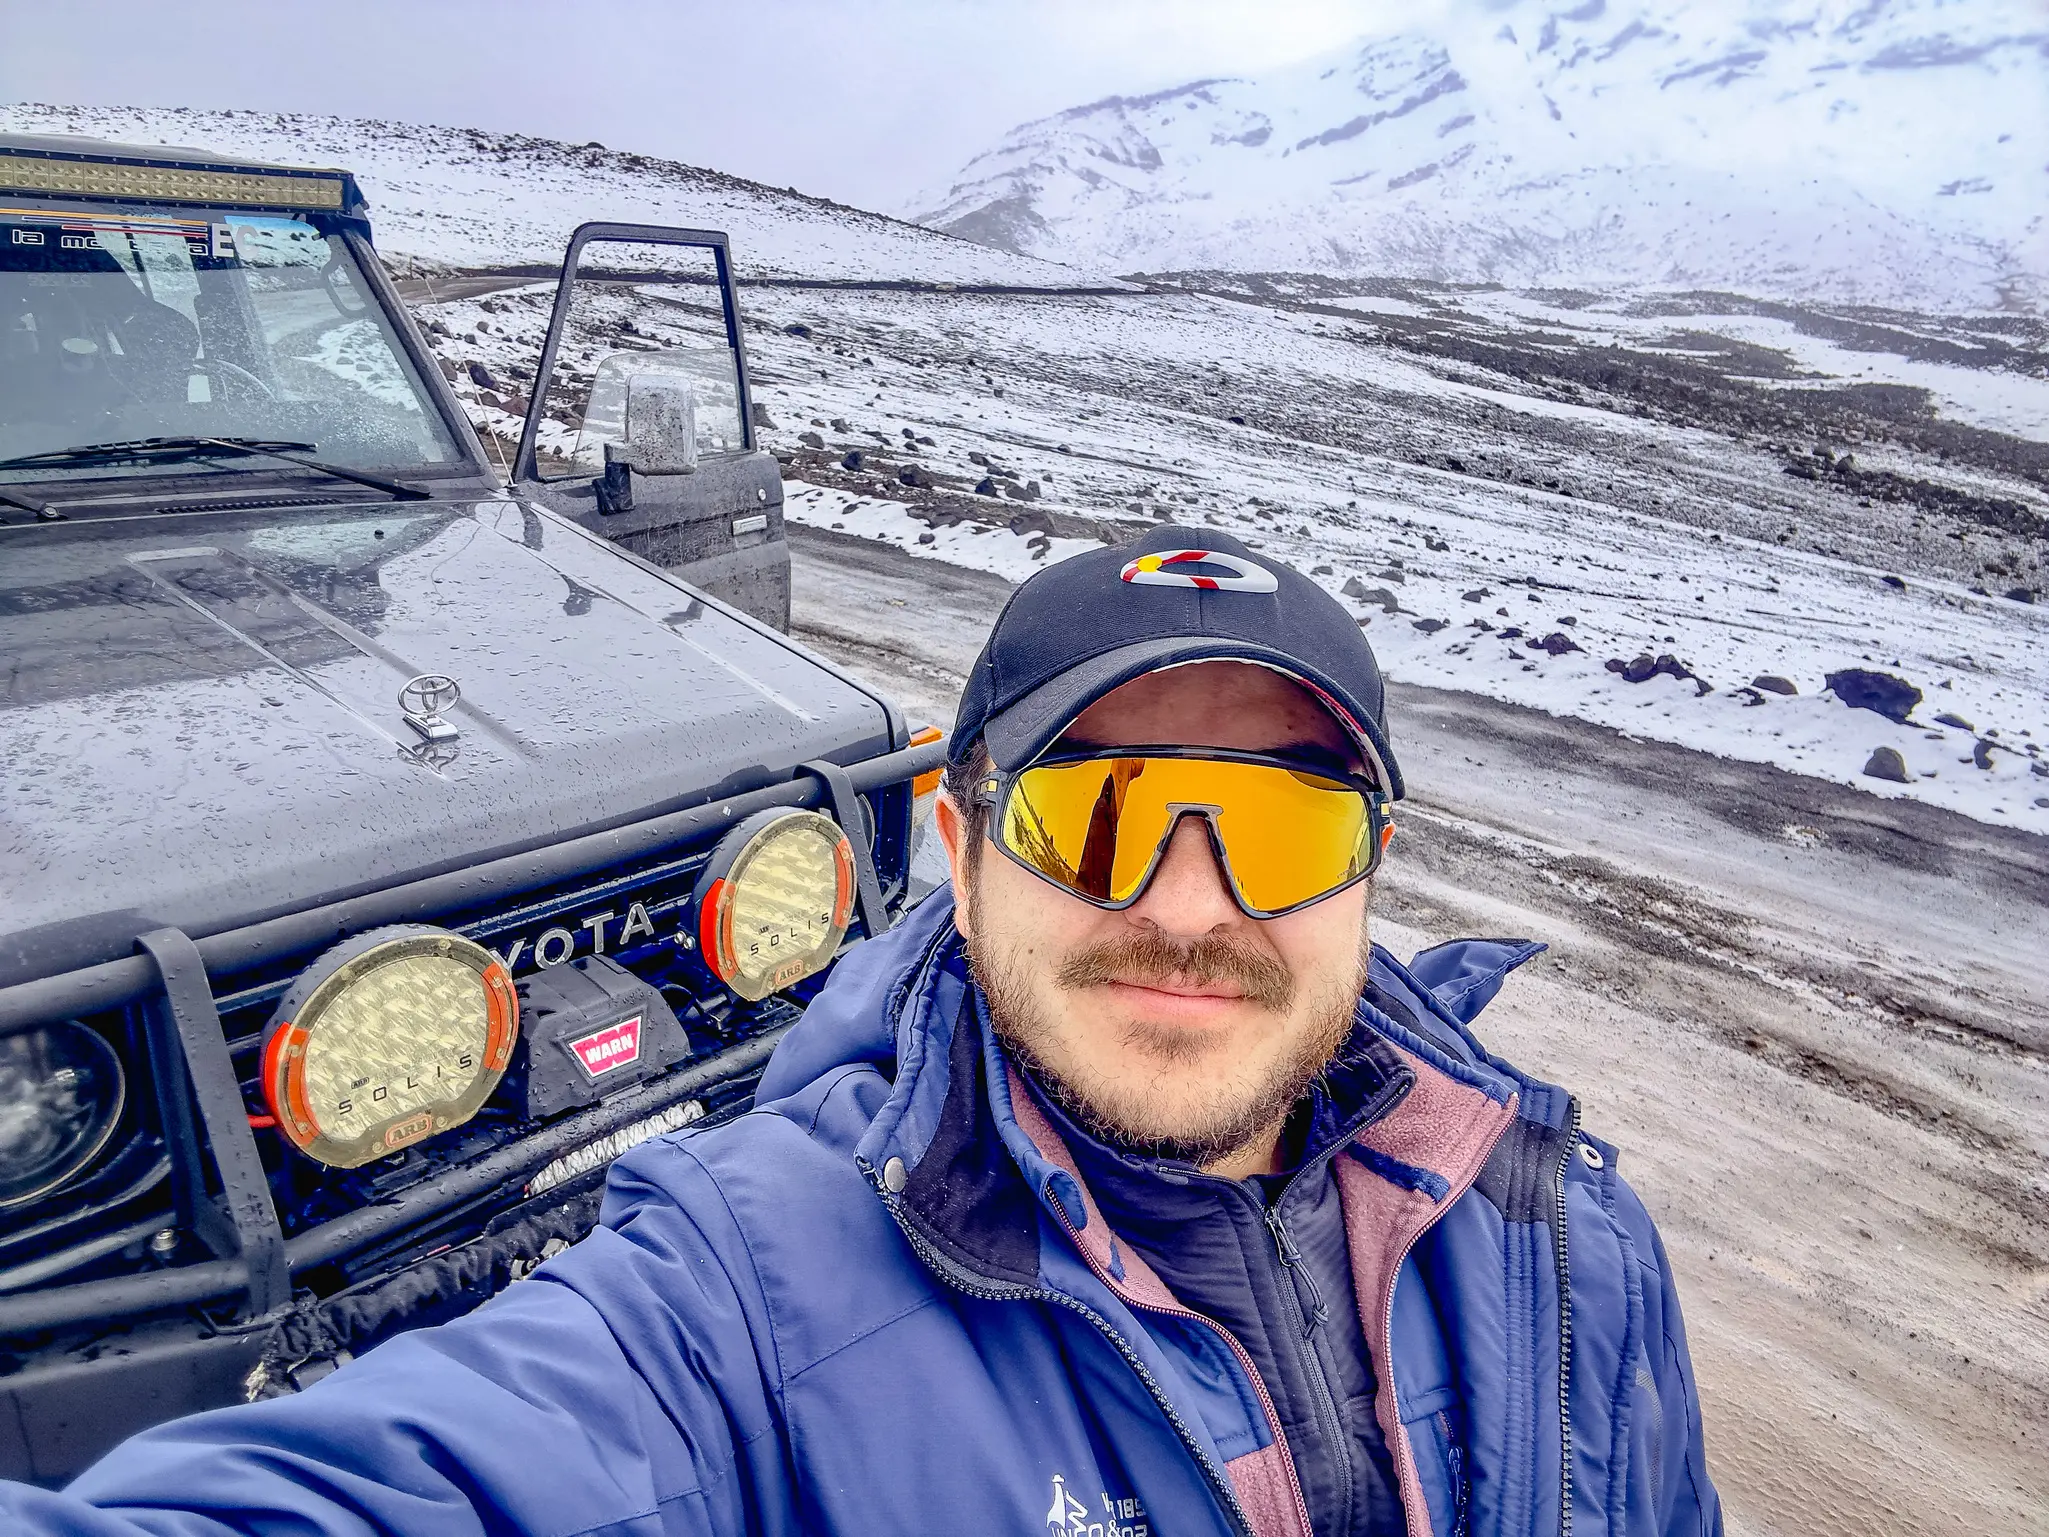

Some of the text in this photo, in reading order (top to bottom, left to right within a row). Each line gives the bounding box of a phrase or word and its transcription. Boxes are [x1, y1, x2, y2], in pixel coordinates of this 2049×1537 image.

[12, 229, 44, 245] la
[489, 902, 655, 977] YOTA
[750, 912, 829, 956] SOLIS
[779, 964, 801, 981] ARB
[585, 1033, 634, 1064] WARN
[338, 1054, 472, 1115] SOLIS
[391, 1117, 428, 1143] ARB
